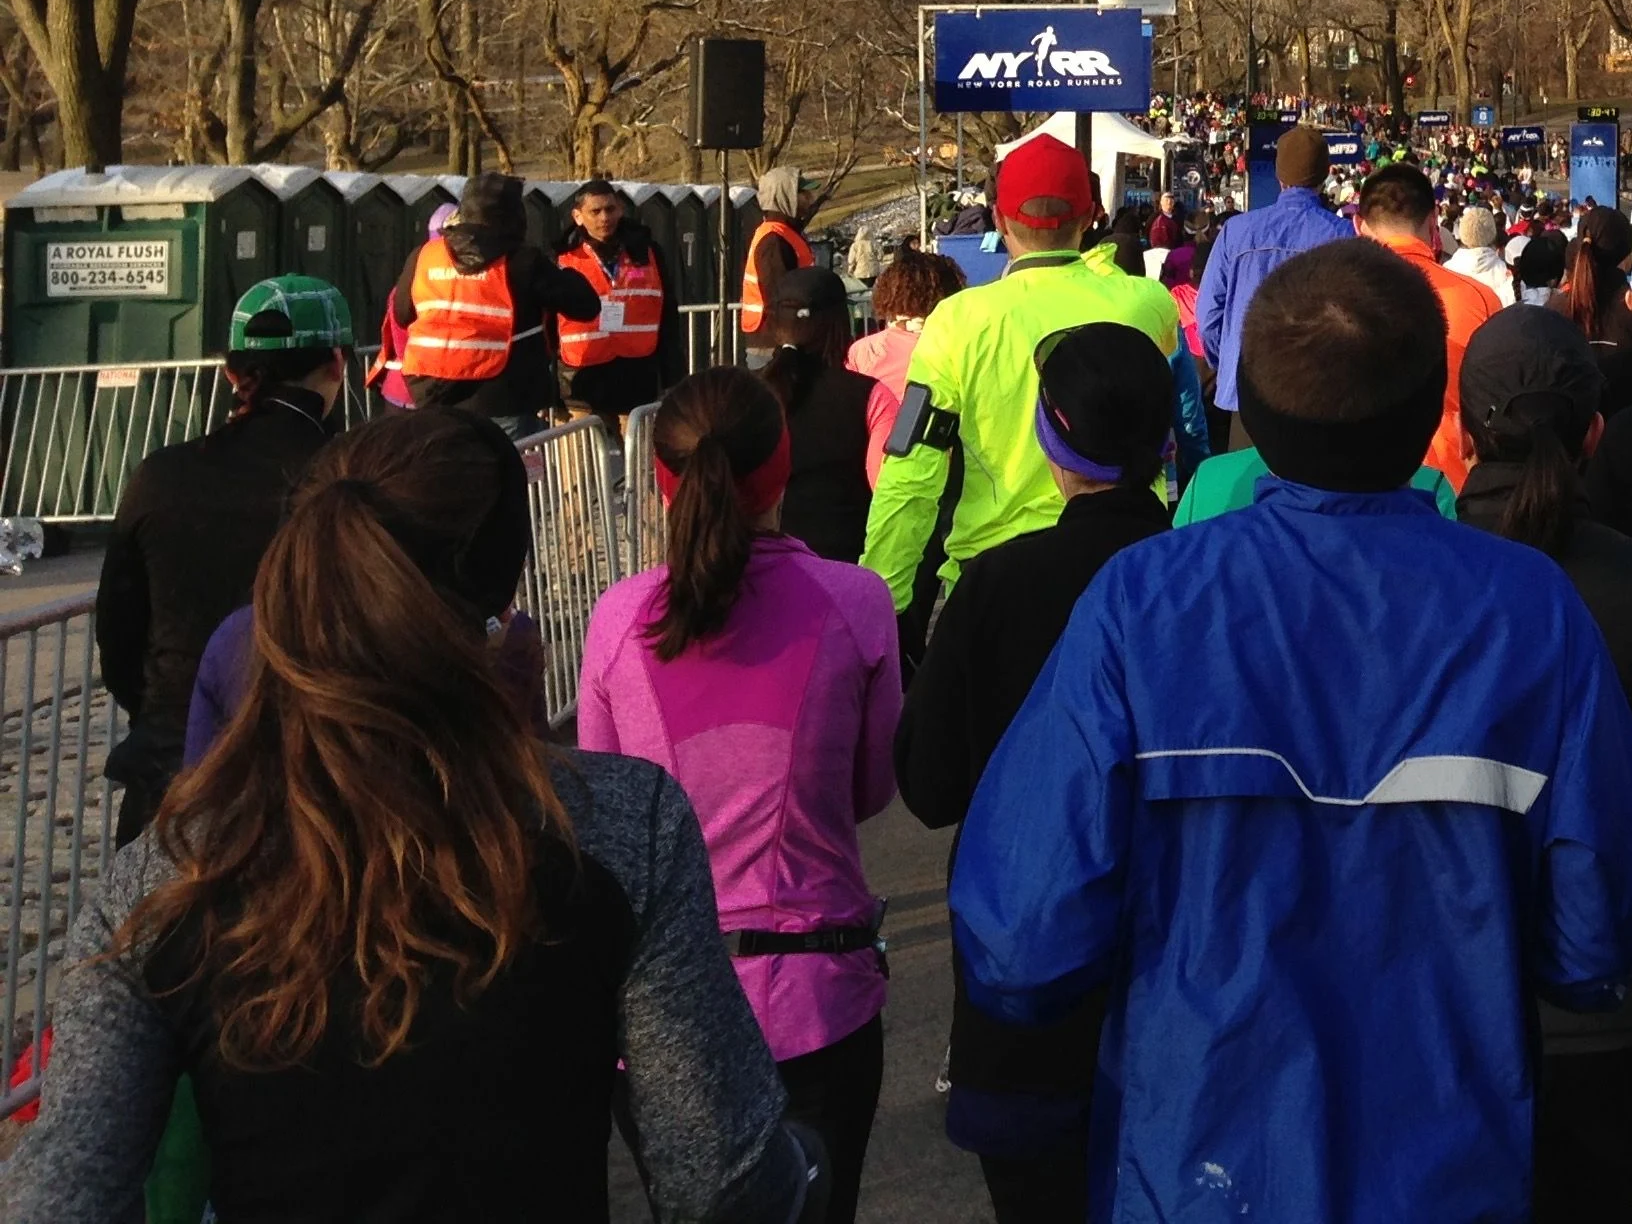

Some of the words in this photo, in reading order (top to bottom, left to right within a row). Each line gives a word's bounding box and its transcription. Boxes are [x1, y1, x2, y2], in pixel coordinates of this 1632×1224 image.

[958, 49, 1120, 79] NYRR
[957, 81, 983, 89] NEW
[989, 80, 1021, 88] YORK
[1027, 79, 1060, 88] ROAD
[1067, 78, 1123, 87] RUNNERS
[52, 246, 62, 260] A
[66, 246, 114, 259] ROYAL
[118, 245, 164, 258] FLUSH
[51, 270, 165, 285] 800-234-6545
